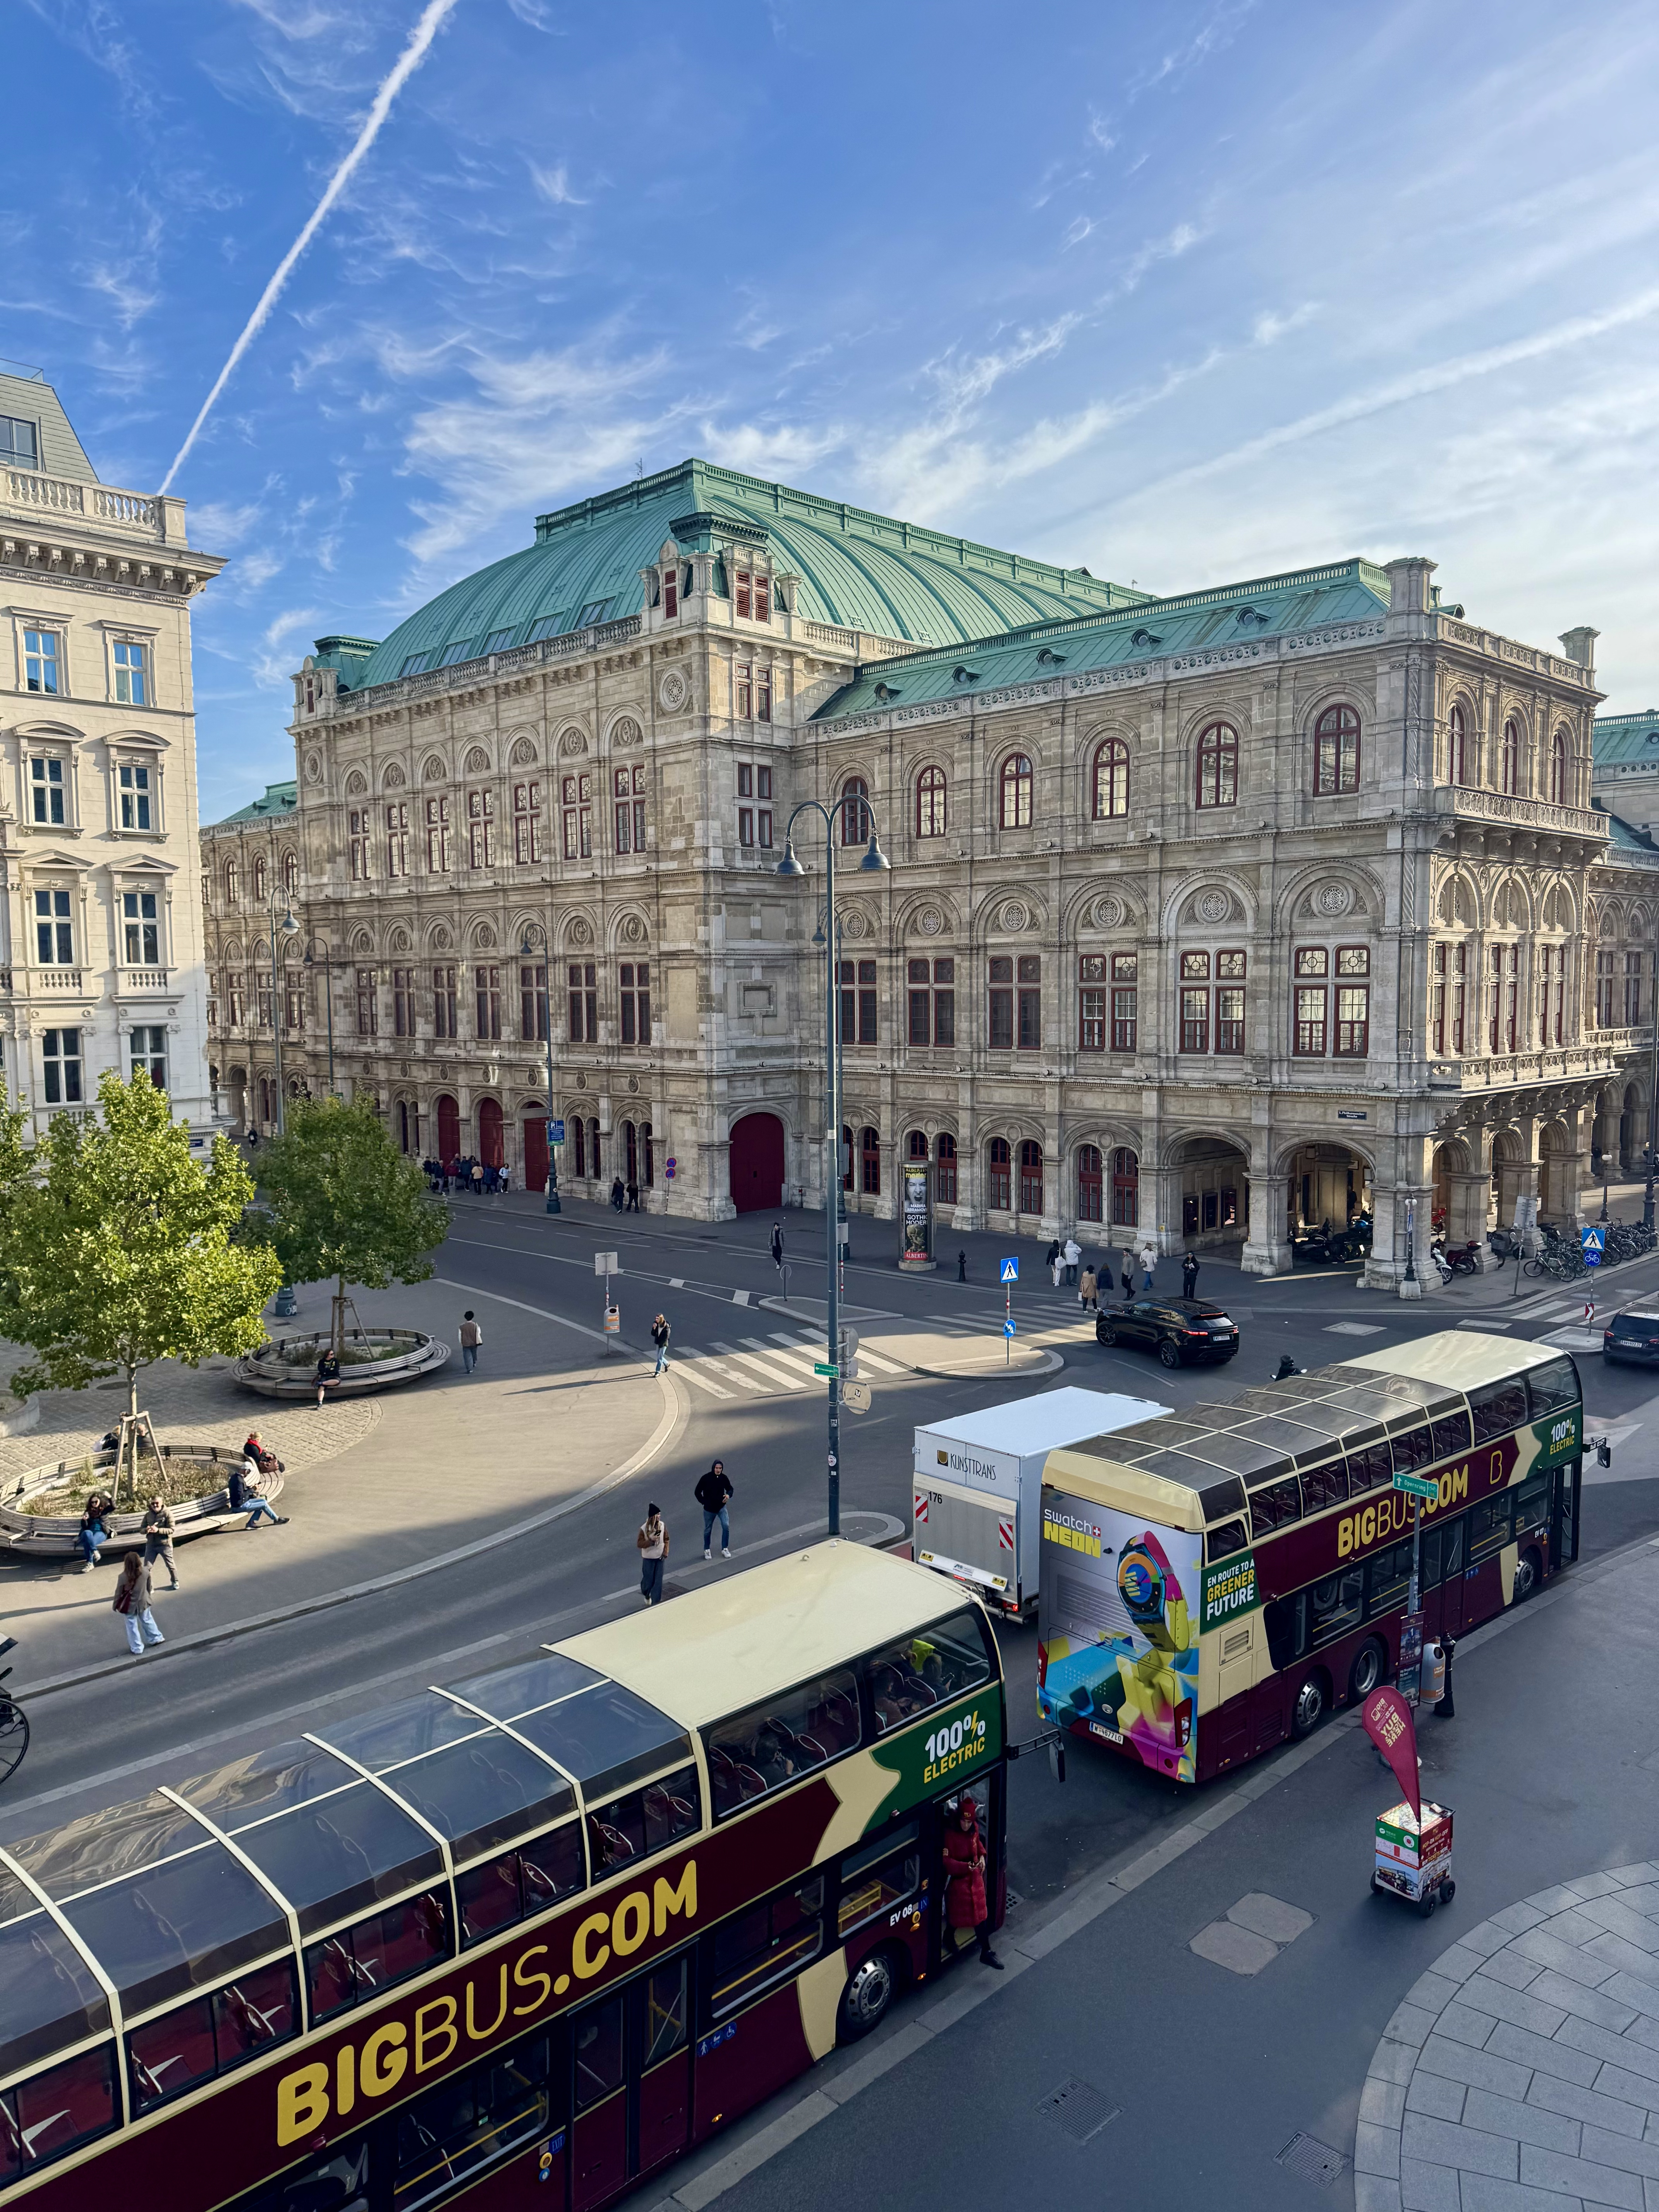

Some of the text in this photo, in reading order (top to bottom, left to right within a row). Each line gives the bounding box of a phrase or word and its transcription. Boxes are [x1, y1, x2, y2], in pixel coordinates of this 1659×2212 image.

[1551, 1418, 1575, 1443] 100%
[1550, 1435, 1575, 1455] ELECTRIC
[951, 1453, 996, 1480] KUNSTTRANS
[929, 1491, 942, 1504] 176
[1404, 1480, 1426, 1492] Opernring
[1044, 1509, 1092, 1534] swatch
[1535, 1529, 1539, 1538] EV
[1044, 1520, 1101, 1558] NEON
[1207, 1559, 1255, 1587] EN ROUTE TO A
[1207, 1569, 1254, 1602] GREENER
[1207, 1583, 1254, 1621] FUTURE
[925, 1711, 985, 1762] 100%
[924, 1737, 985, 1784] ELECTRIC
[890, 1904, 912, 1926] EV 08
[277, 1860, 697, 2147] BIGBUS.COM
[552, 2136, 562, 2152] EXIT
